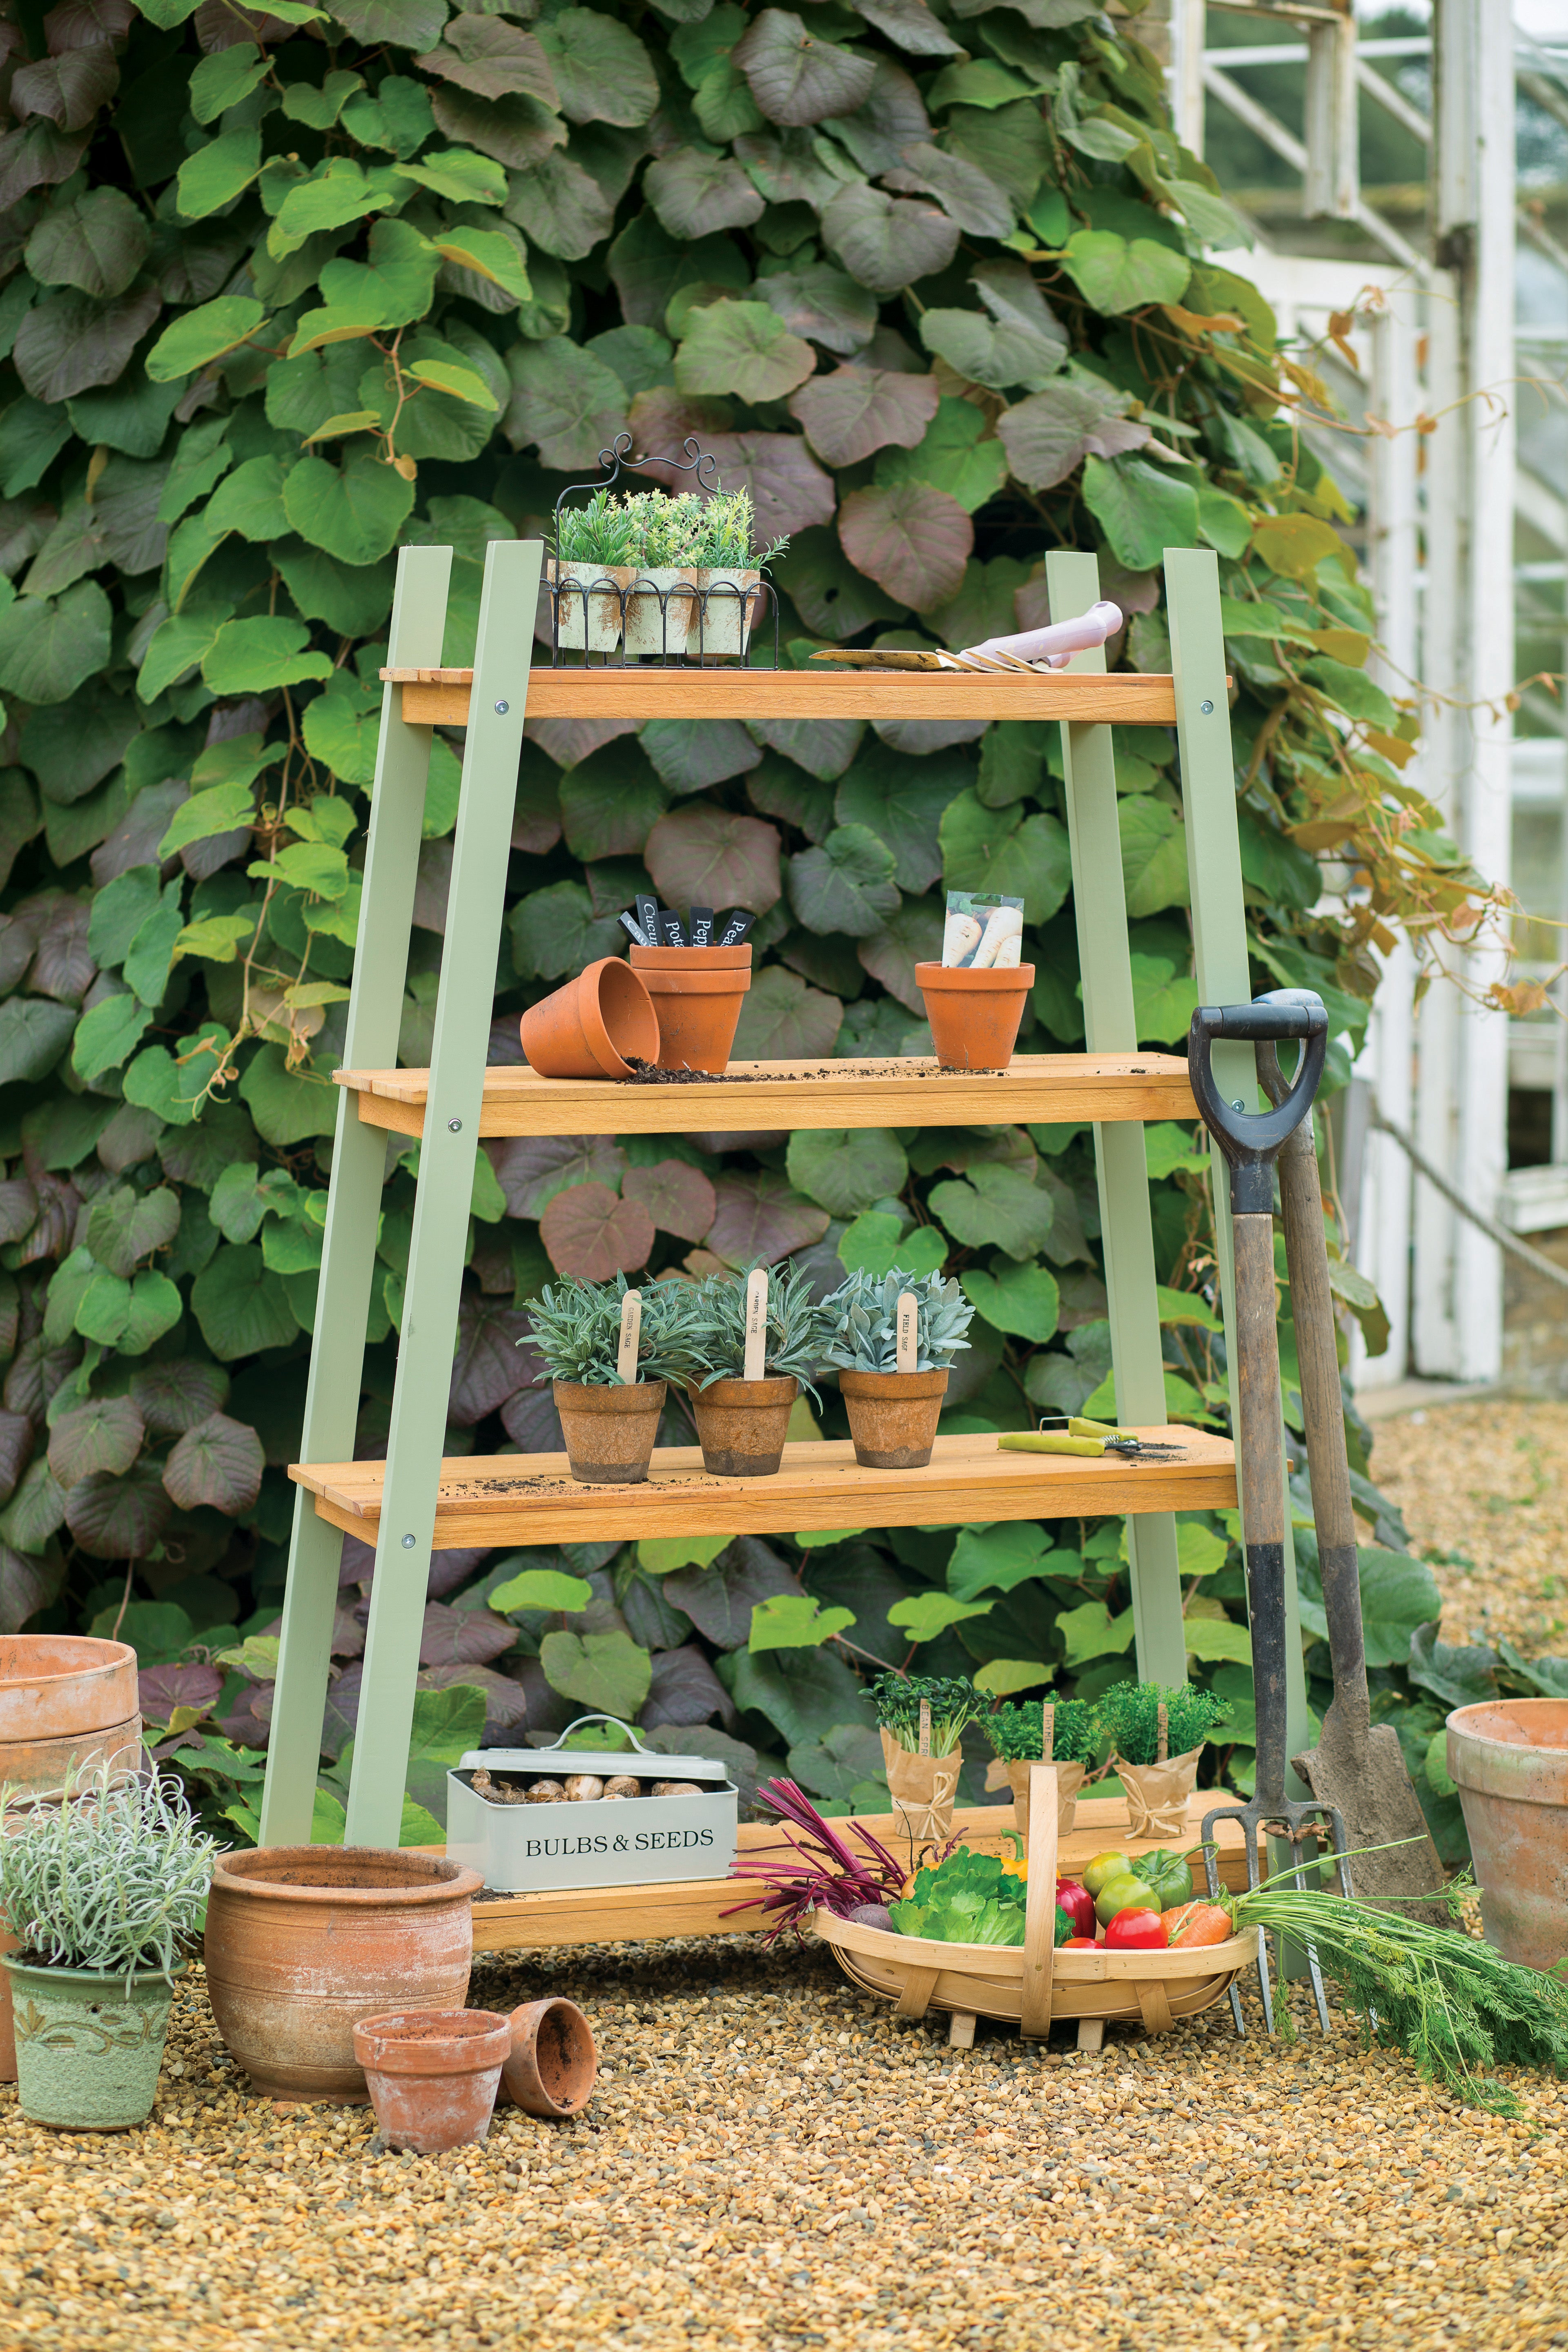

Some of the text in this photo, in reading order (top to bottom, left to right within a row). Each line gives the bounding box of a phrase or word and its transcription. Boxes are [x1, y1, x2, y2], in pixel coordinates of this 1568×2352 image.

[627, 920, 652, 947] Cau
[526, 1829, 714, 1857] BULBS & SEEDS
